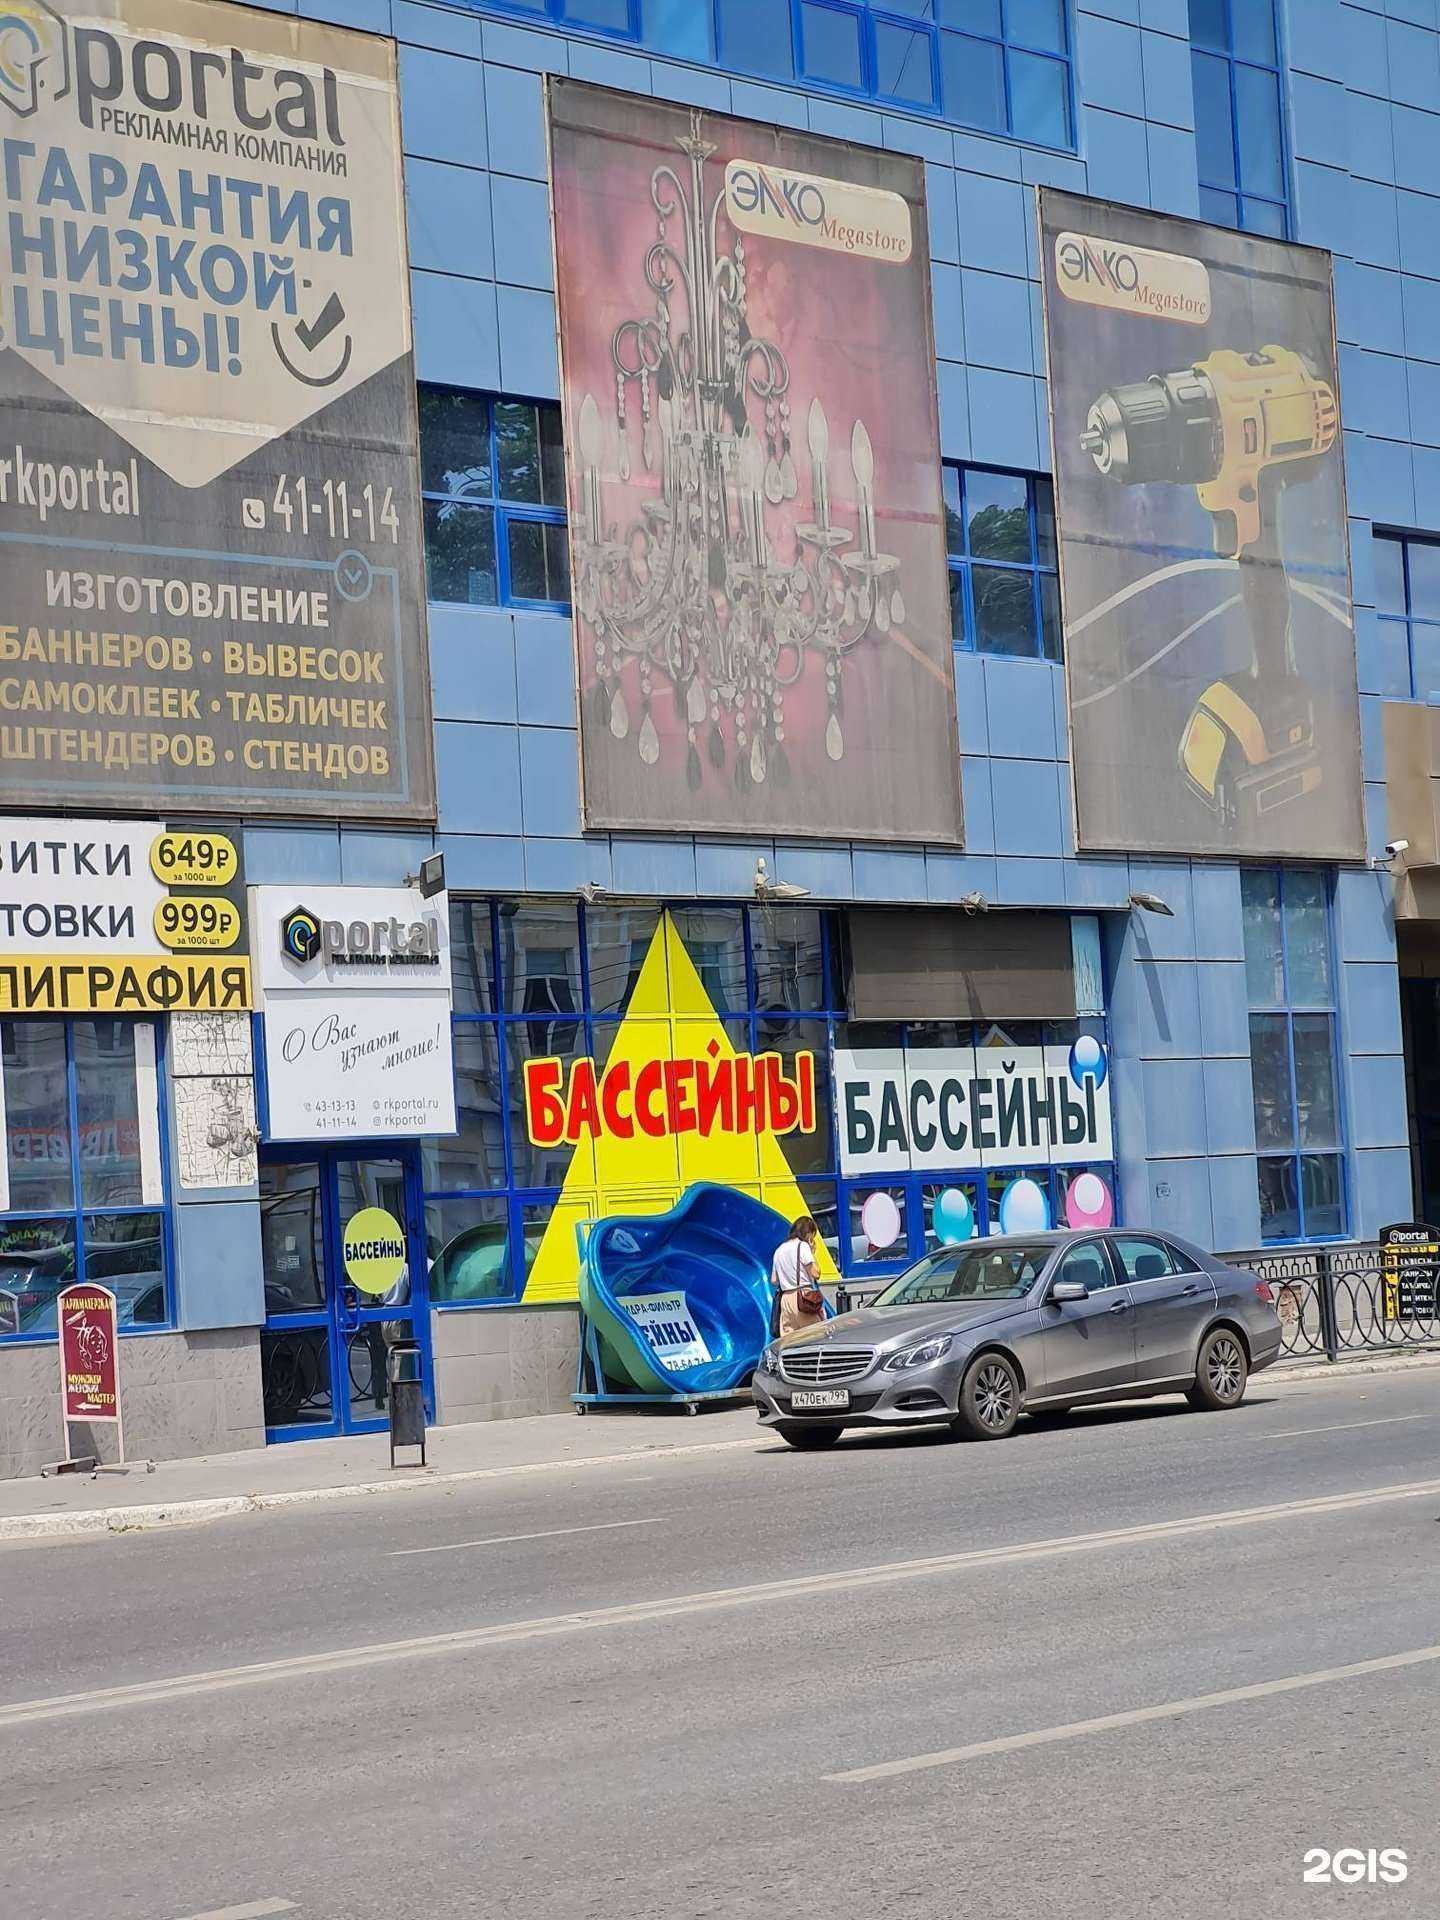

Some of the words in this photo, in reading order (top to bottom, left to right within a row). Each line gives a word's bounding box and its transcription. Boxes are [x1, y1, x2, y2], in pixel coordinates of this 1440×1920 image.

[74, 27, 347, 146] portal
[101, 107, 228, 156] РЕКЛАМНАЯ
[235, 133, 348, 178] КОМПАНИЯ
[3, 138, 354, 257] ГАРАНТИЯ
[820, 217, 907, 253] Megastore
[8, 211, 298, 315] НИЗКОЙ
[1134, 285, 1207, 316] Megastore
[13, 285, 243, 377] ЦЕНЫ!
[273, 474, 400, 545] 41-11-14
[46, 569, 330, 628] ИЗГОТОВЛЕНИЕ
[0, 625, 194, 672] БАННЕРОВ
[223, 641, 385, 685] ВЫВЕСОК
[0, 677, 202, 720] САМОКЛЕЕК
[227, 691, 388, 730] ТАБЛИЧЕК
[0, 725, 216, 771] ШТЕНДЕРОВ
[243, 738, 390, 779] СТЕНДОВ
[0, 840, 131, 876] ИТКИ
[184, 872, 205, 881] 1000
[0, 903, 135, 938] ТОВКИ
[188, 936, 208, 945] 1000
[323, 916, 440, 967] portal
[312, 1013, 357, 1052] Вас
[341, 1030, 400, 1072] узнают
[382, 1023, 441, 1071] многие!
[315, 1100, 356, 1112] 43-13-13
[524, 1038, 815, 1146] БАССЕЙНЫ
[844, 1059, 1098, 1155] БАССЕЙНЫ
[316, 1117, 357, 1128] 41-11-14
[345, 1236, 404, 1262] БАССЕЙНЫ
